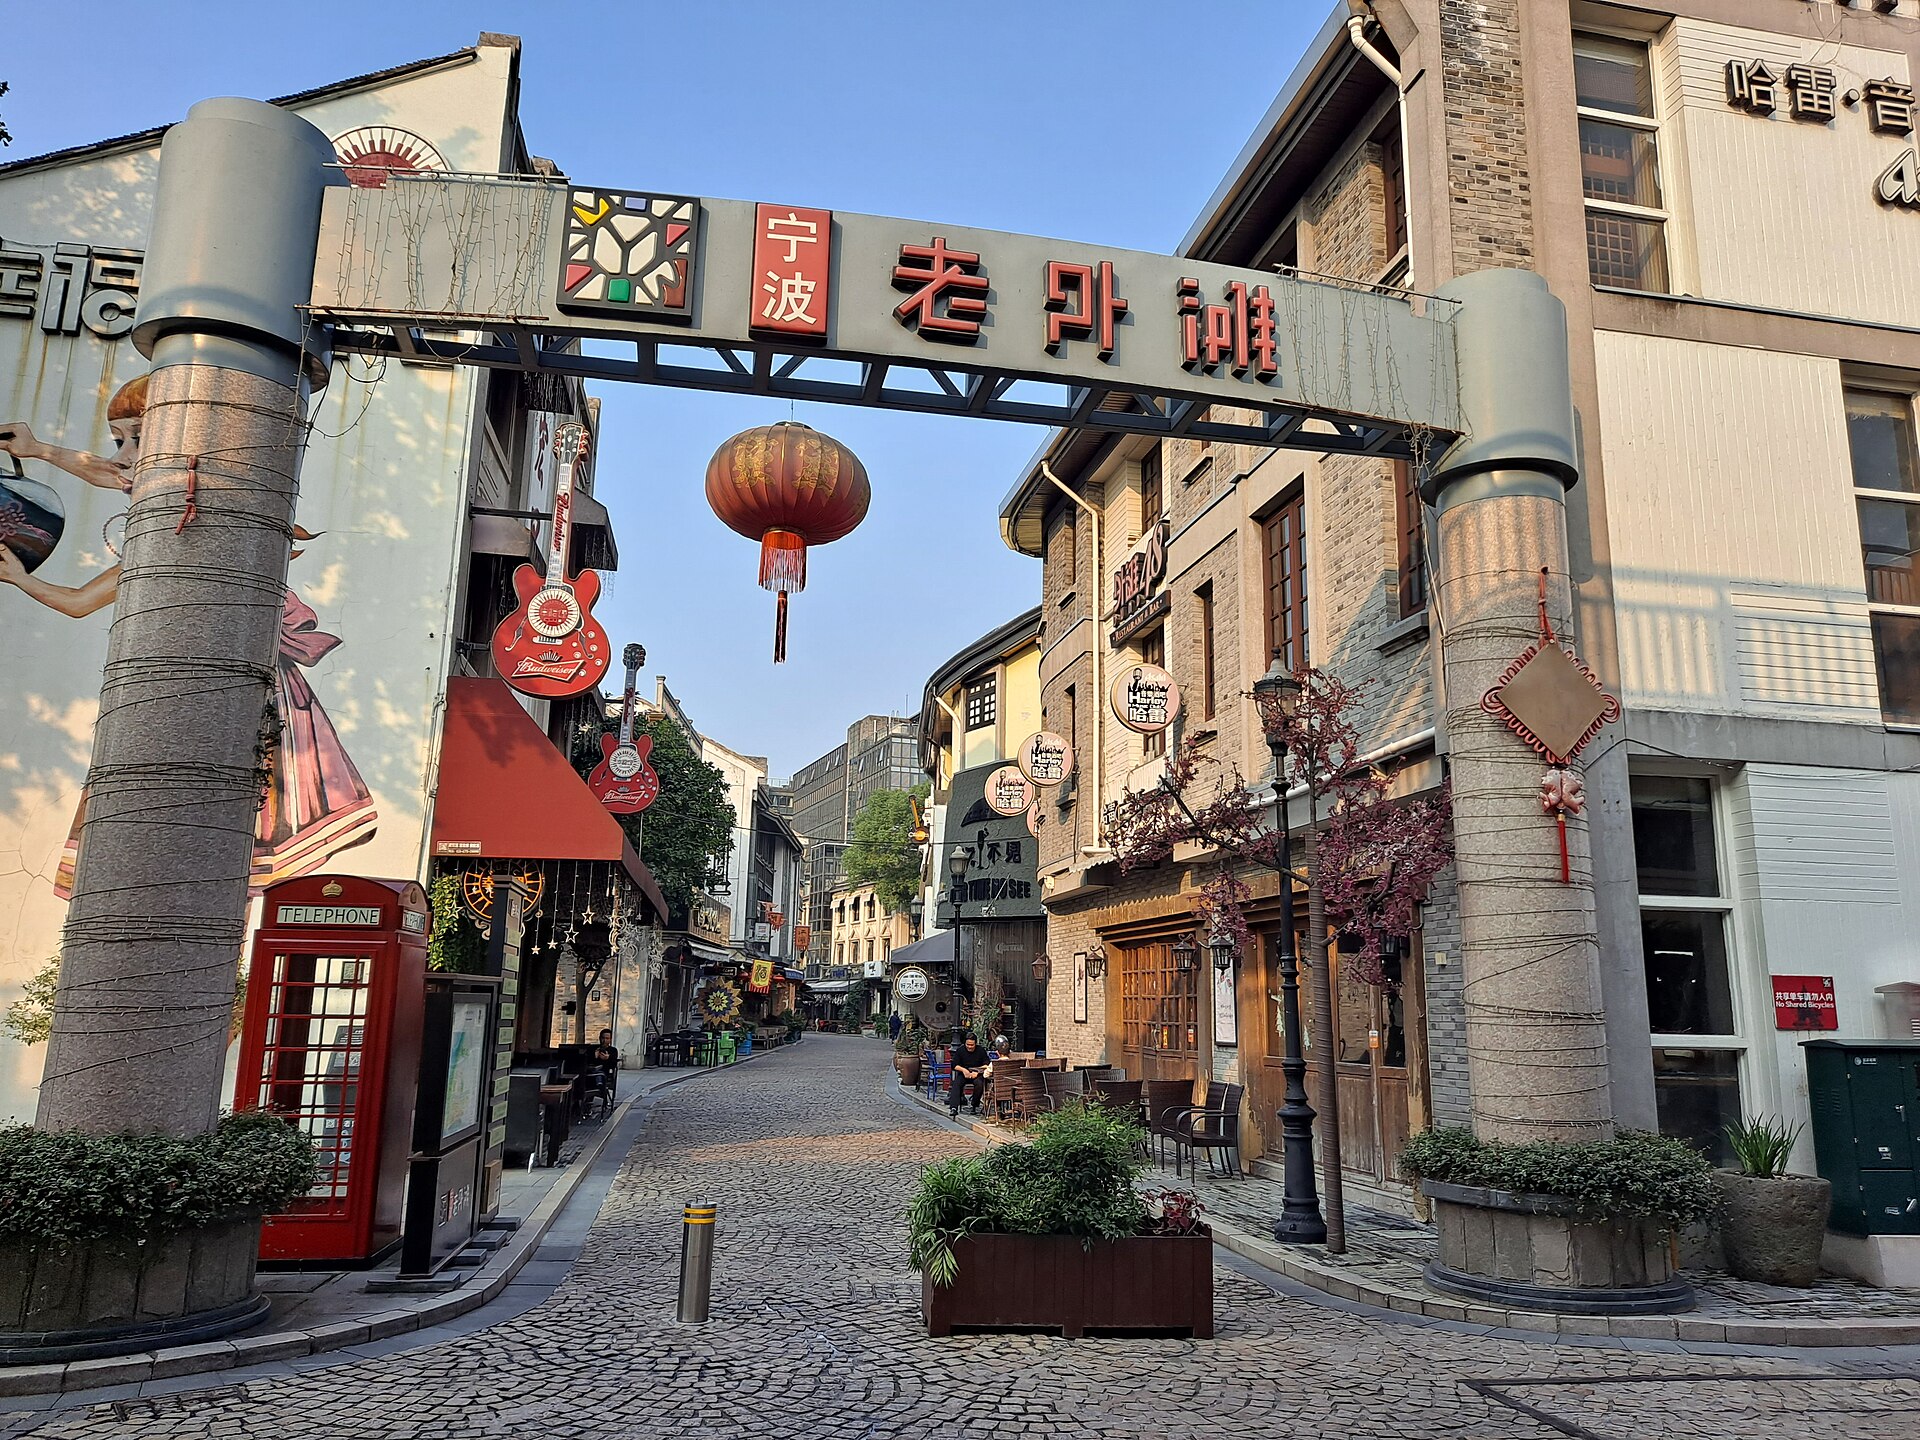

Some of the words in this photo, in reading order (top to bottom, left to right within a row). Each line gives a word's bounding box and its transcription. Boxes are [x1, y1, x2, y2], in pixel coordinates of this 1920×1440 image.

[760, 211, 819, 325] 宁波
[892, 236, 1280, 383] 老外滩
[551, 492, 570, 553] Budweiser
[517, 659, 577, 675] Budweiser
[1129, 691, 1167, 707] Harley
[1129, 707, 1166, 723] 哈雷
[1032, 753, 1062, 767] Harley
[1008, 878, 1031, 899] SEE
[280, 907, 379, 924] TELEPHONE
[1808, 1001, 1834, 1010] Bicycles
